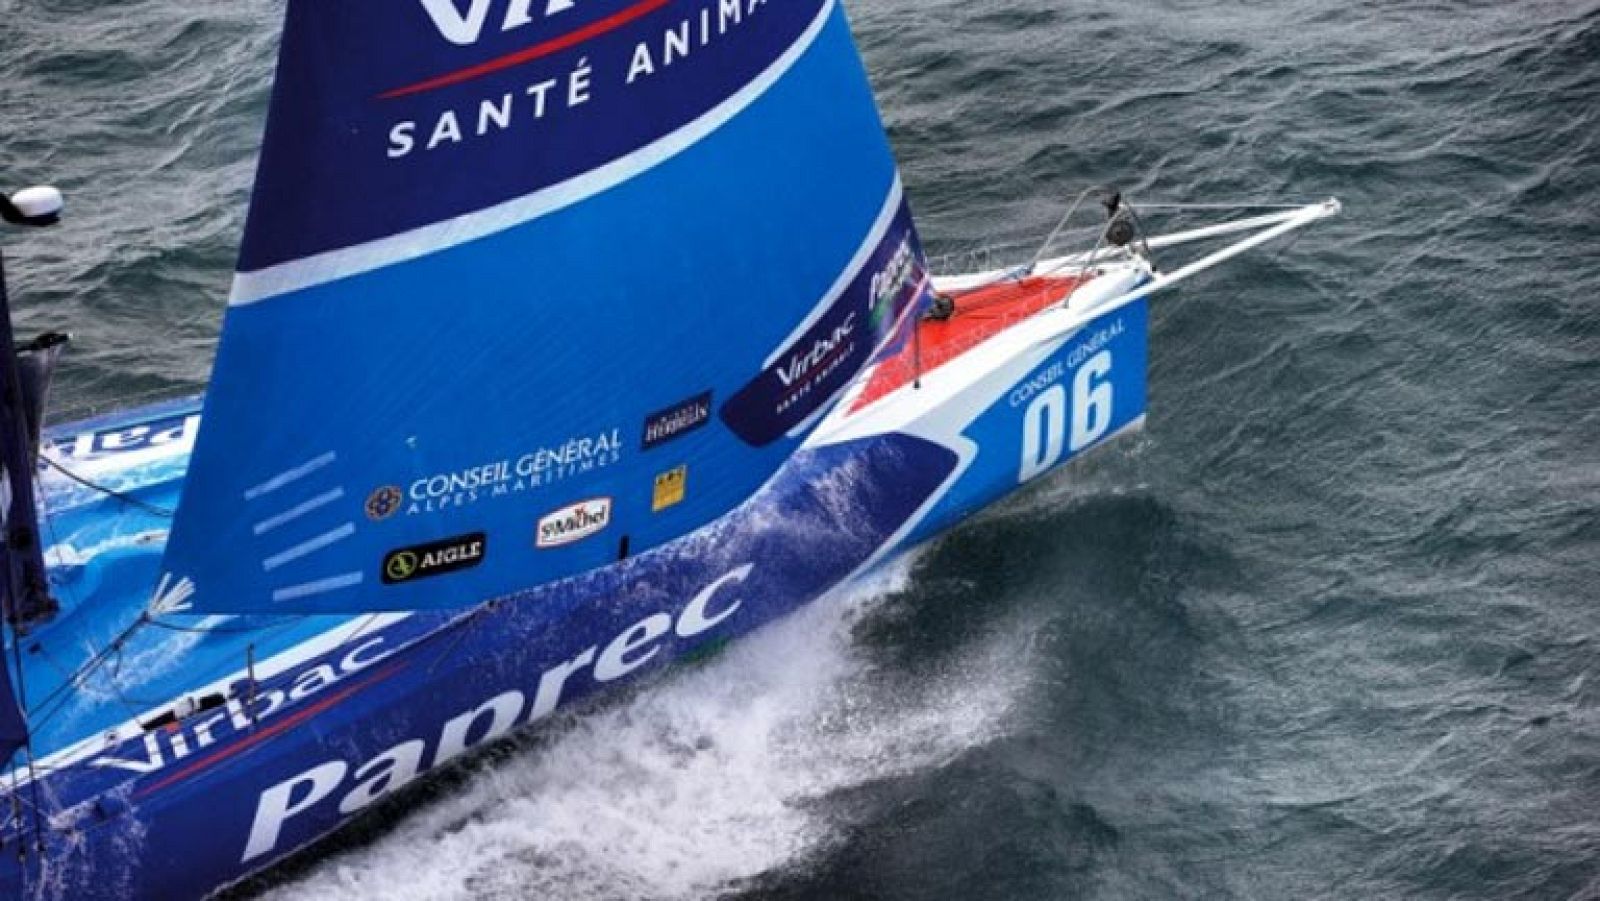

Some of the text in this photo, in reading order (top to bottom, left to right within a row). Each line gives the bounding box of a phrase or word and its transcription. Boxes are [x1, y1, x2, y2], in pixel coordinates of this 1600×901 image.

[387, 57, 592, 158] SANTÉ
[1018, 350, 1113, 484] 06
[409, 460, 513, 500] CONSEIL
[420, 541, 482, 570] AIGLE
[87, 637, 386, 773] Virbac
[241, 562, 755, 863] Paprec
